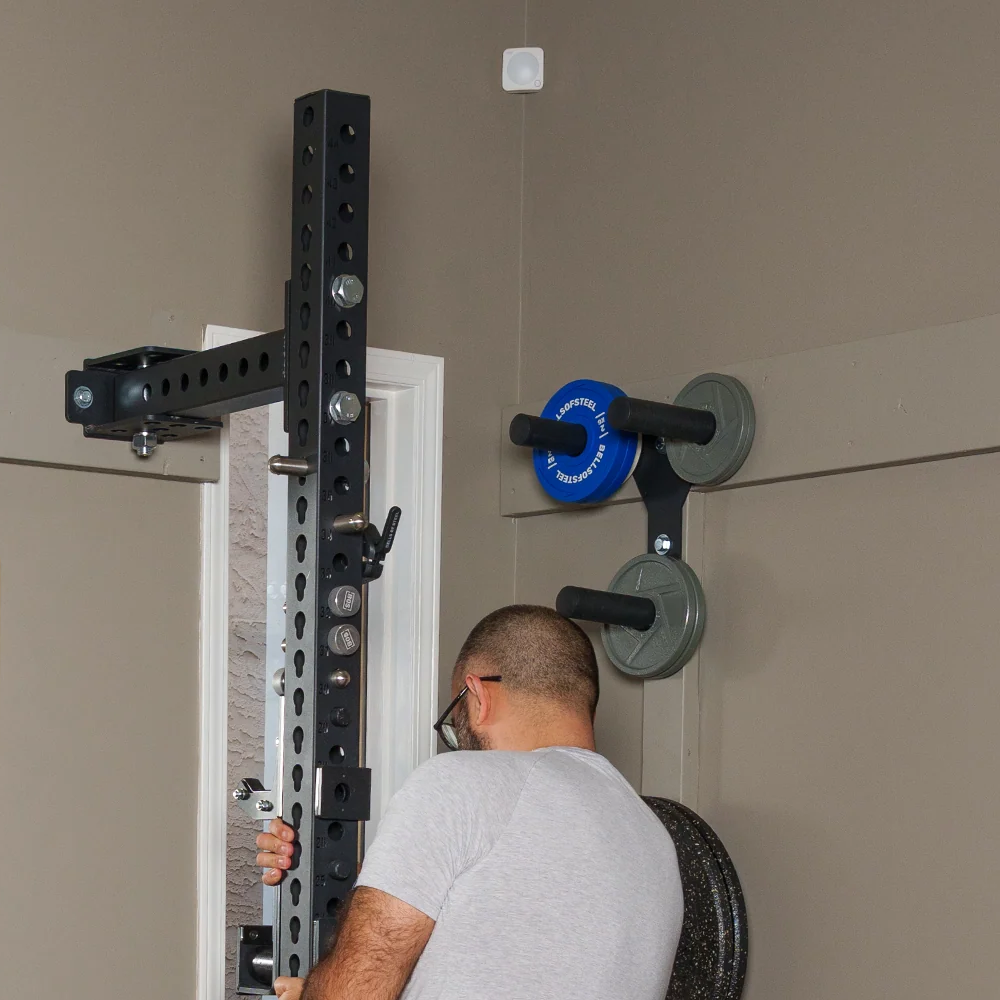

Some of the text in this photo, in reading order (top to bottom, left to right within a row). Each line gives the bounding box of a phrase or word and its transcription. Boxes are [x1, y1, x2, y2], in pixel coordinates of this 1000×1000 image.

[556, 397, 596, 421] LSOFSTEEL
[556, 444, 605, 484] BELLSOFSTEEL
[345, 594, 353, 609] BOS
